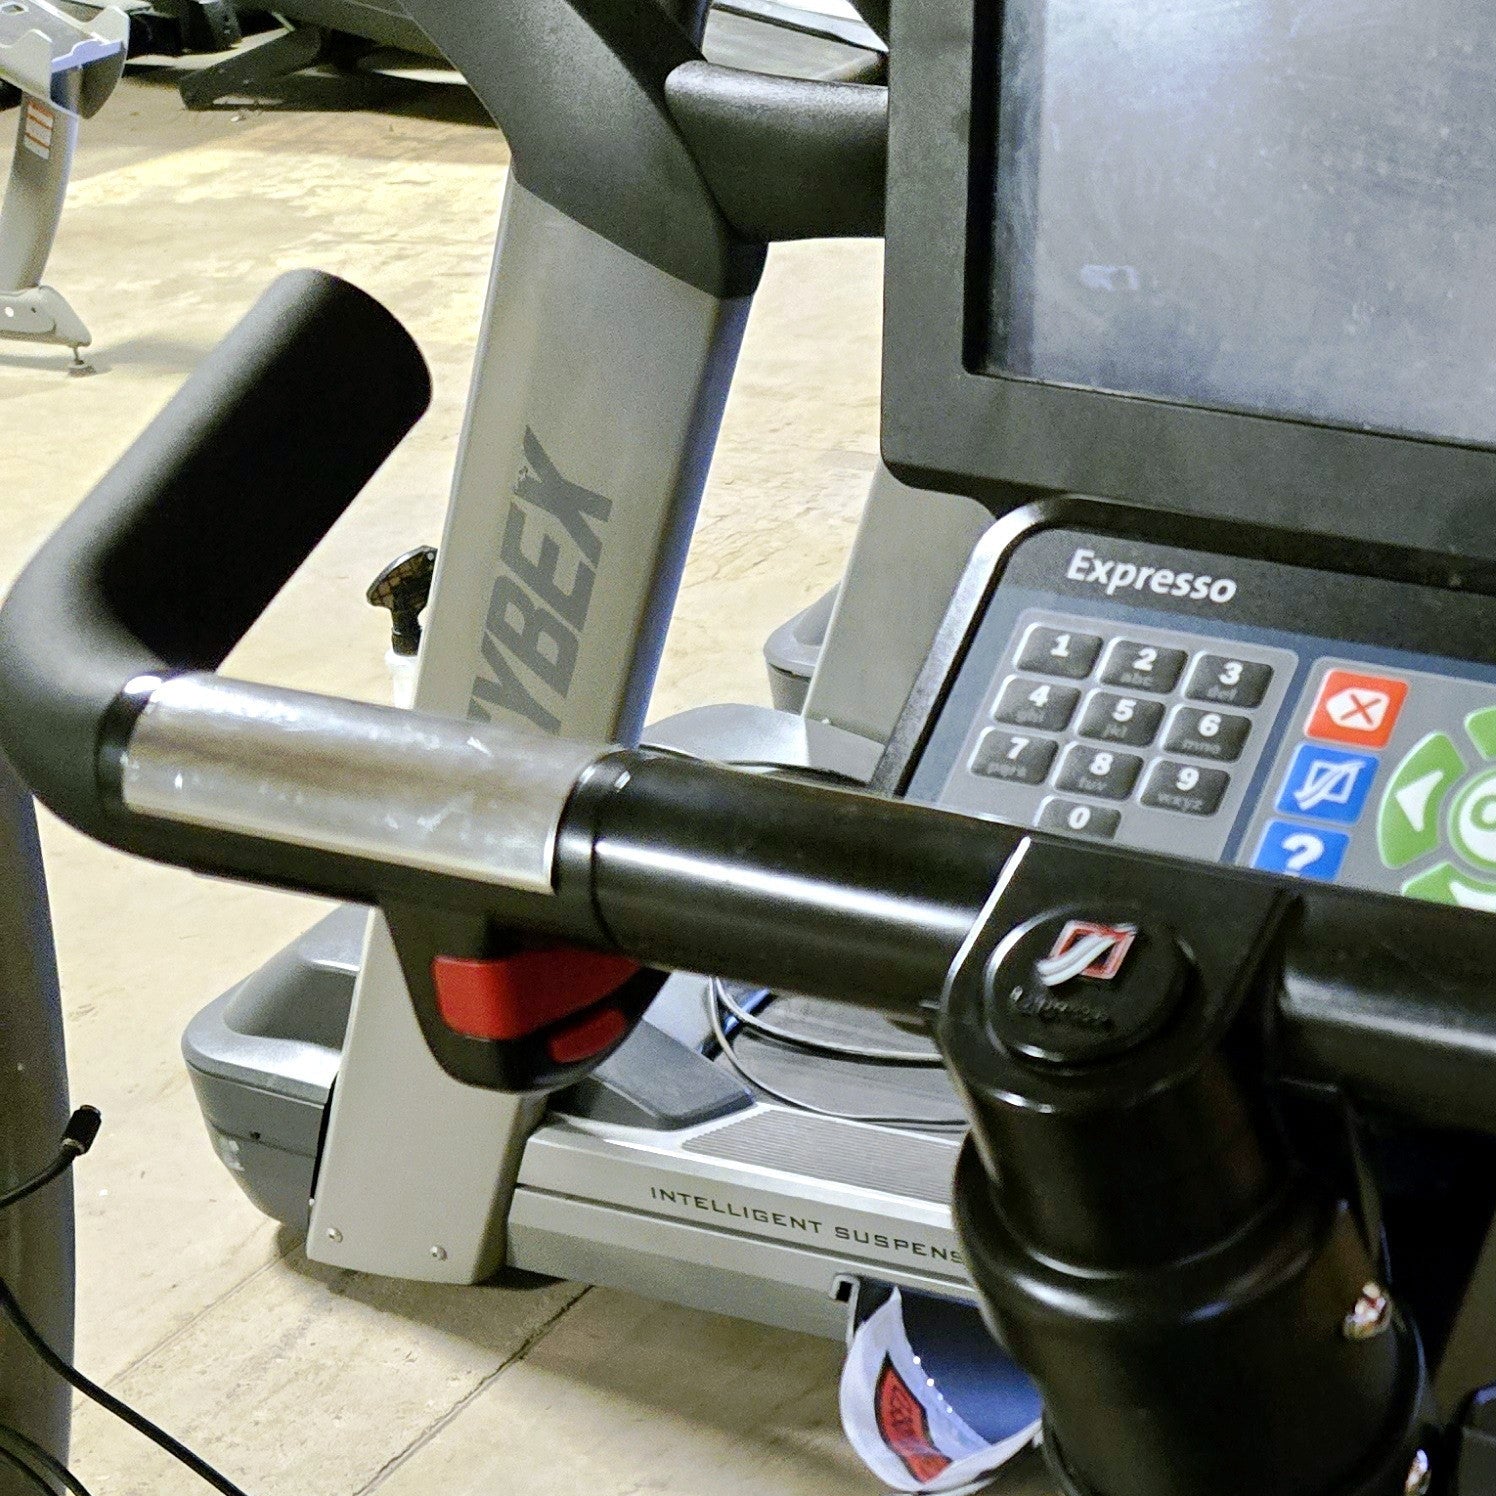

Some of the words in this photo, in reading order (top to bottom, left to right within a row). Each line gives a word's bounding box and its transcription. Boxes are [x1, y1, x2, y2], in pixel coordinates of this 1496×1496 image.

[467, 425, 613, 738] YBEX
[1066, 548, 1238, 604] Expresso
[1050, 634, 1071, 658] 1
[1132, 647, 1158, 671] 2
[1218, 660, 1244, 686] 3
[1029, 685, 1051, 707] 4
[1112, 699, 1137, 722] 5
[1199, 713, 1222, 737] 6
[1008, 737, 1030, 760] 7
[1089, 752, 1113, 776] 8
[1176, 767, 1200, 791] 9
[1068, 806, 1091, 830] 0
[650, 1186, 823, 1234] INTELLIGENT
[834, 1226, 964, 1264] SUSPENS
